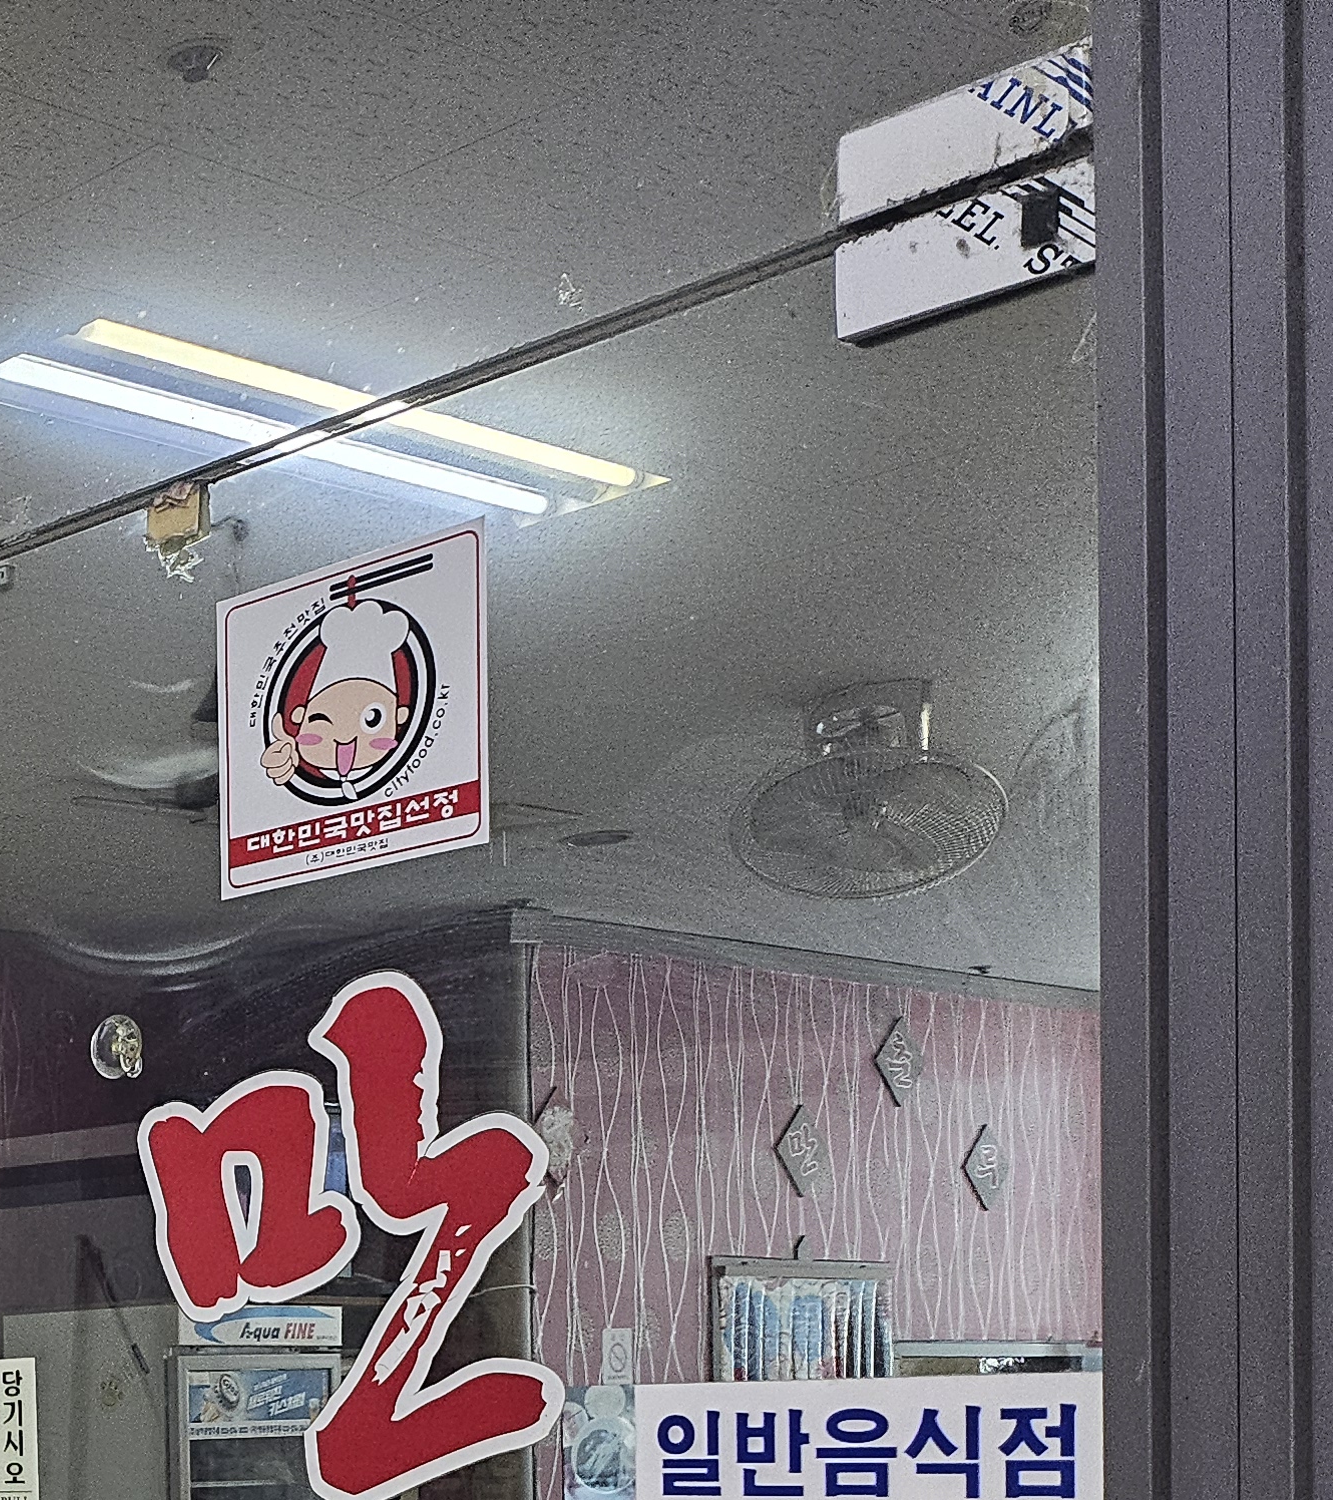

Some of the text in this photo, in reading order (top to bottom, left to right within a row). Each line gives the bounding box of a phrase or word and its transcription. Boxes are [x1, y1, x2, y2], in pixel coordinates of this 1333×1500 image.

[1023, 243, 1079, 275] S
[249, 597, 326, 728] 대한민국추천맛집
[246, 788, 459, 854] 대한민국맛집선정
[305, 837, 390, 866] (주)대한민국맛집
[283, 1322, 316, 1340] FINE
[1, 1369, 26, 1485] 당기시오
[656, 1401, 1078, 1500] 일반음식점
